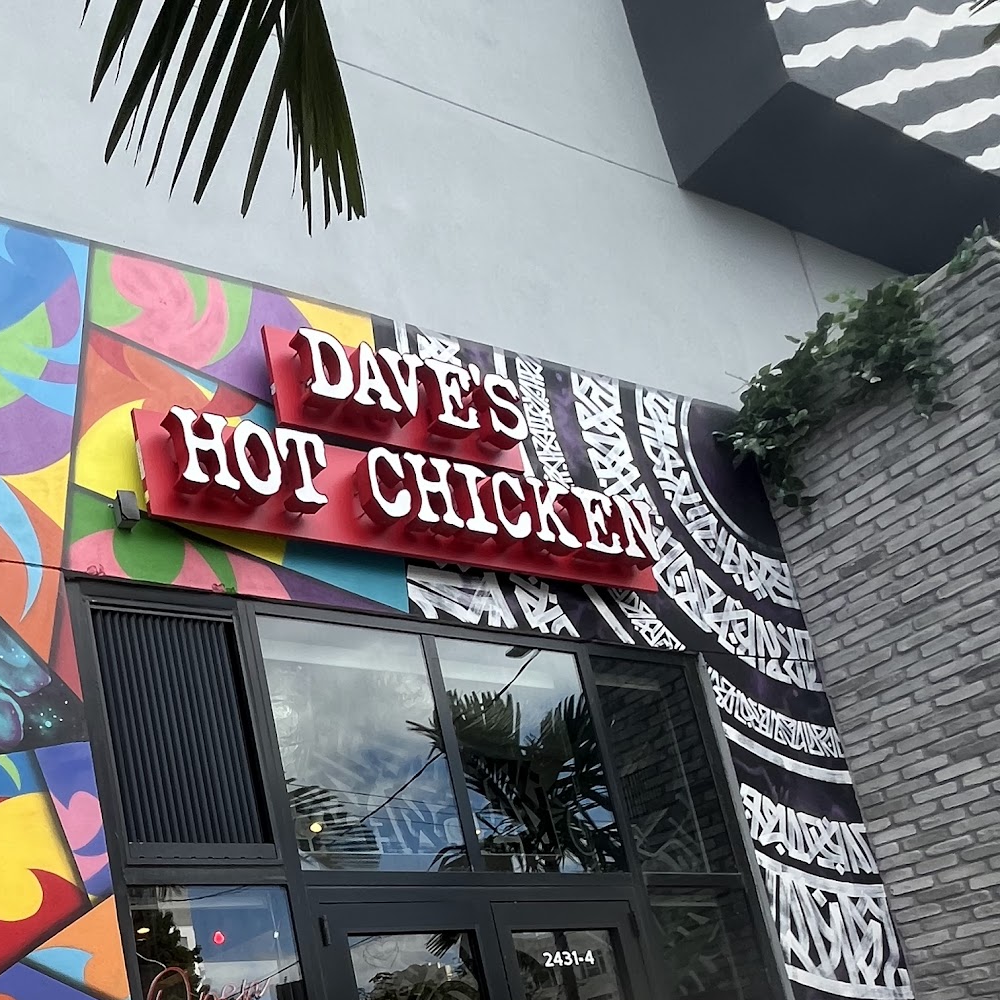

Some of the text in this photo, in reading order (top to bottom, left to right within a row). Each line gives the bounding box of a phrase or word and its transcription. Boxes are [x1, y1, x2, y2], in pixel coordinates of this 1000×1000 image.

[299, 327, 530, 441] DAVE'S
[171, 405, 662, 562] HOT CHICKEN
[542, 950, 595, 967] 2431-4
